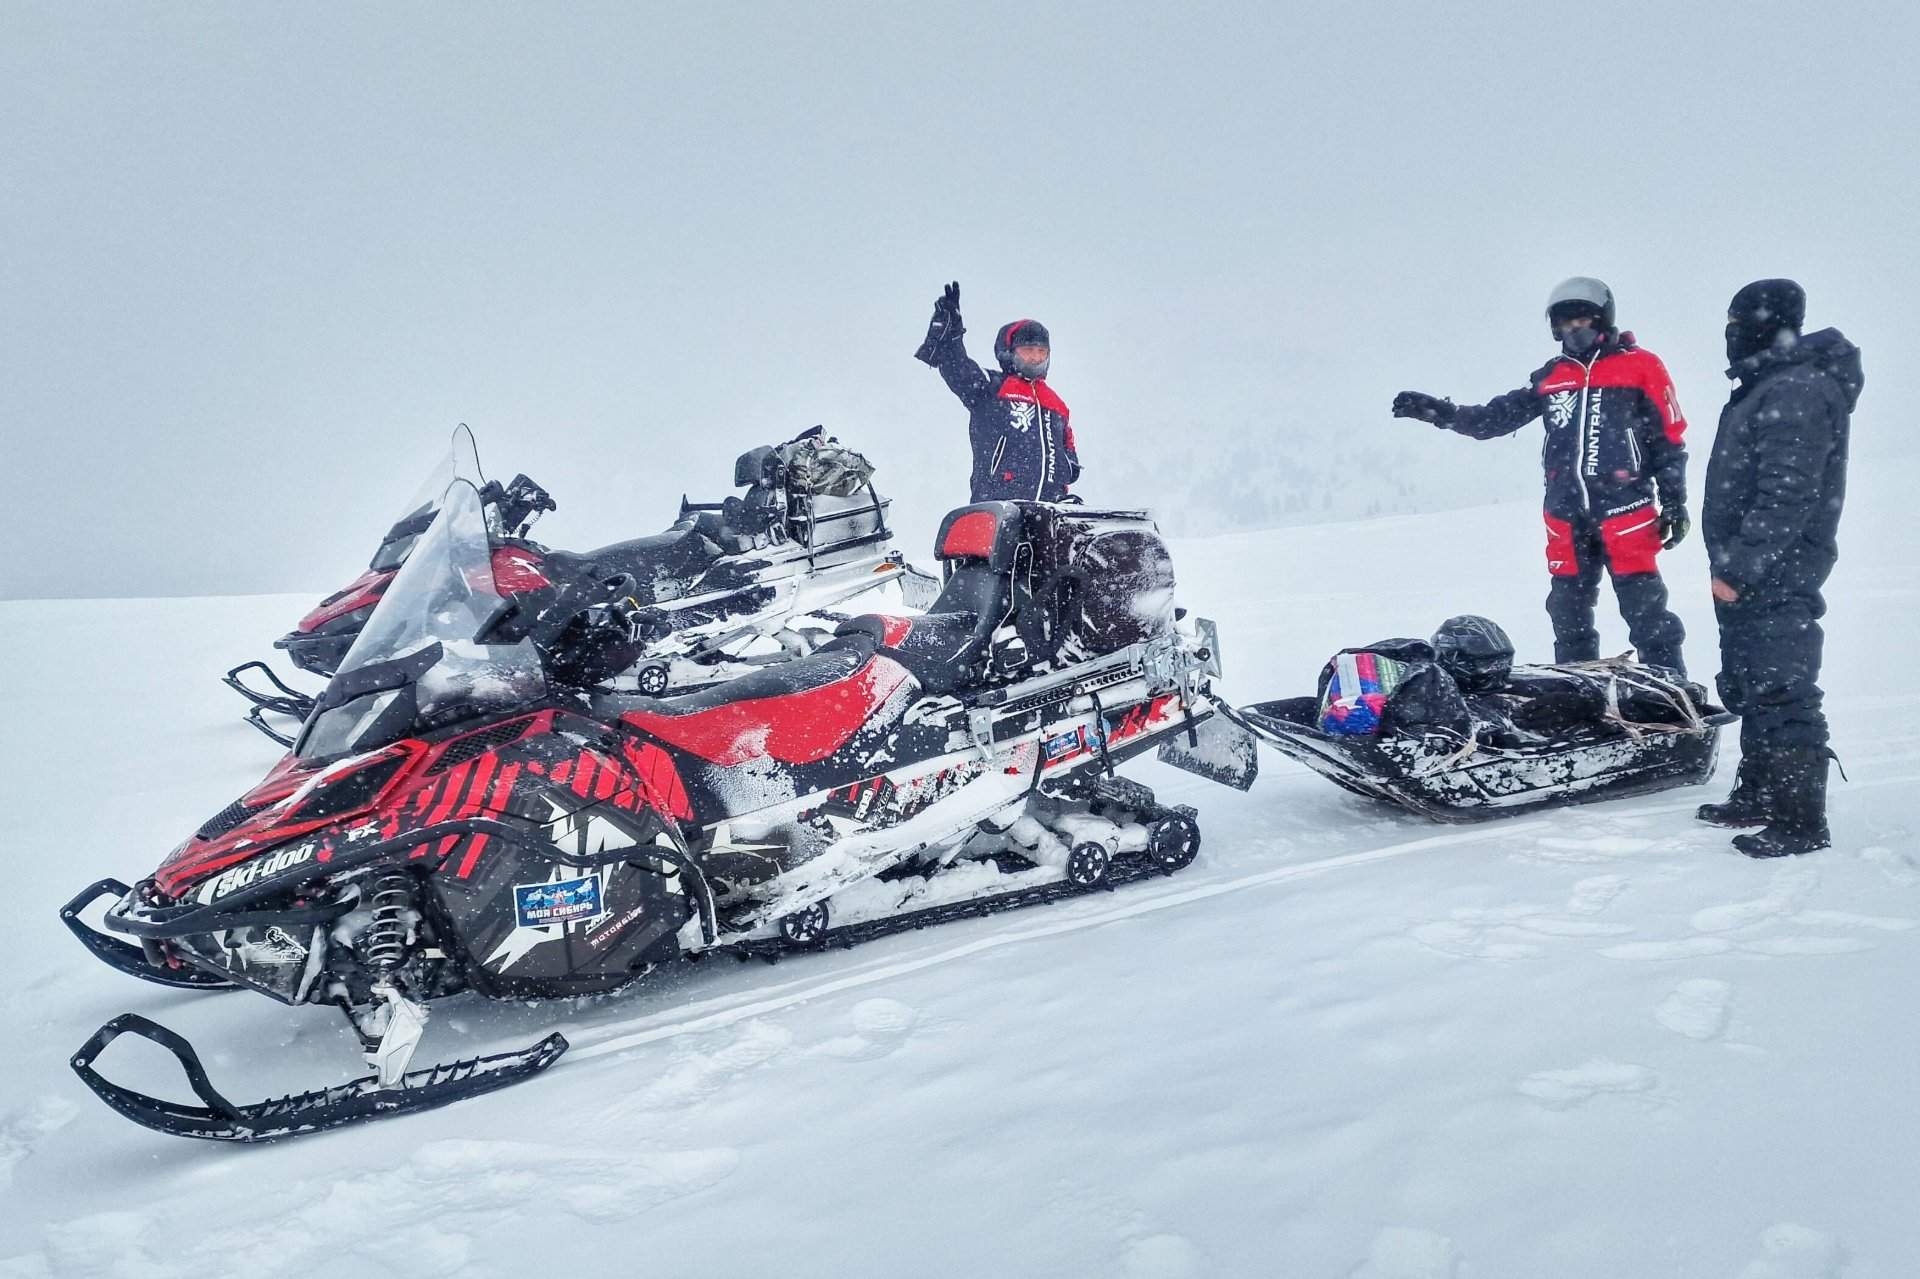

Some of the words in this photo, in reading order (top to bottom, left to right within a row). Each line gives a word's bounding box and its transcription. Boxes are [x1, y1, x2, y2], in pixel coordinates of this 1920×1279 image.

[1044, 409, 1055, 483] FINNTRAIL
[1586, 387, 1602, 476] FINNTRAIL
[526, 908, 551, 920] МОЯ
[553, 901, 593, 918] СИБИРЬ
